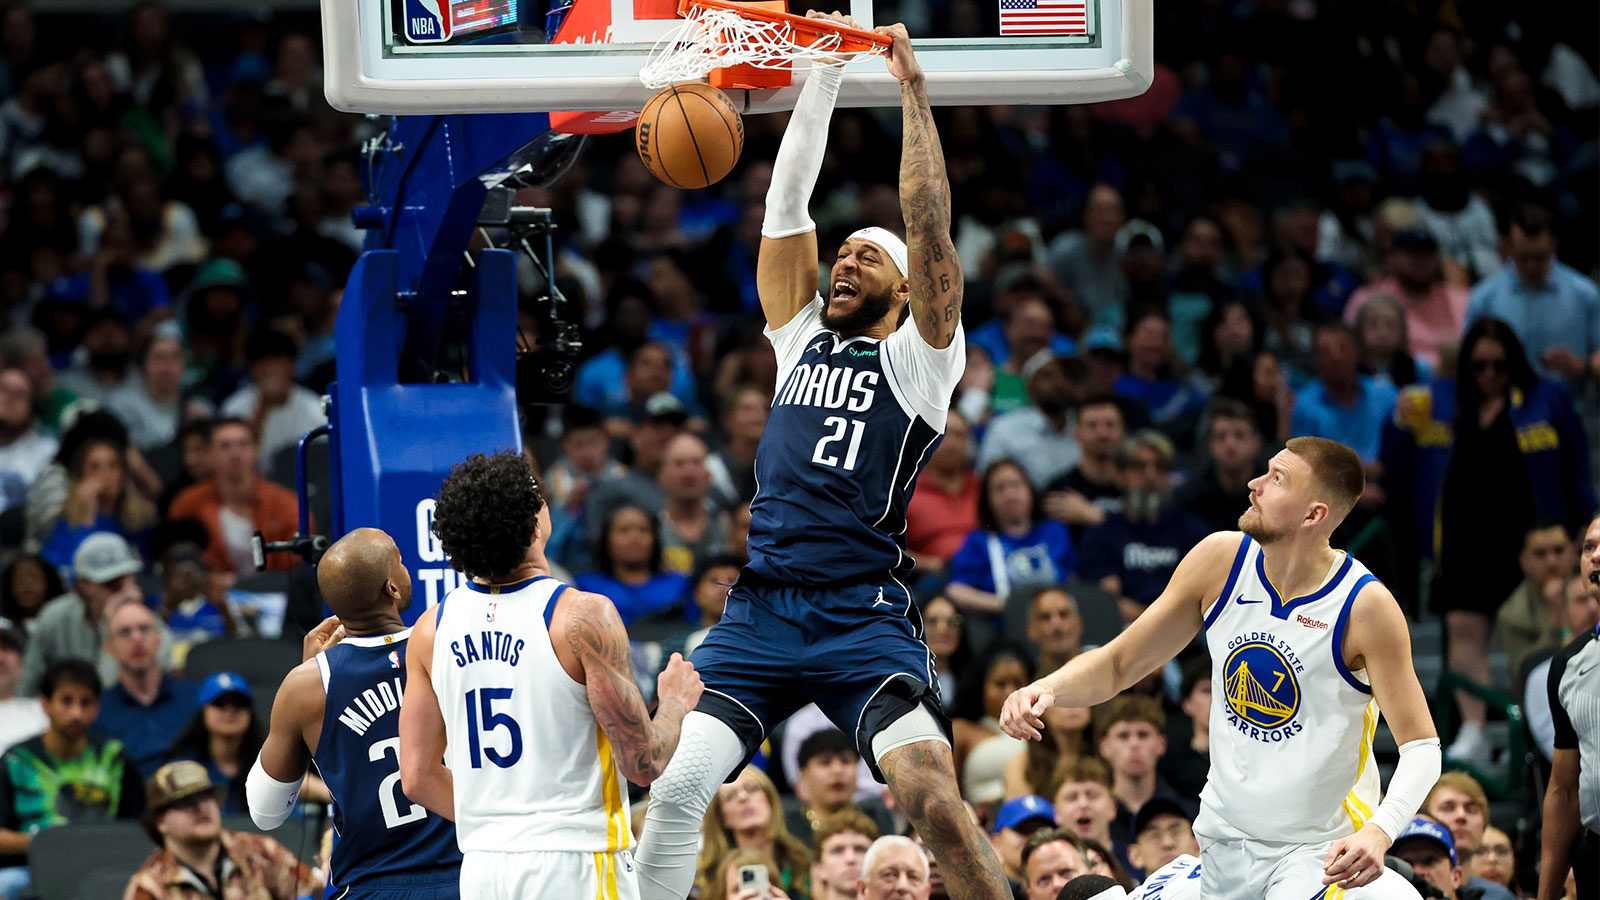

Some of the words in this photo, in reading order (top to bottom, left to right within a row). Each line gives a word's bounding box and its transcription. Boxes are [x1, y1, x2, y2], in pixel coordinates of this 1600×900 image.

[411, 17, 436, 35] NBA
[849, 347, 878, 358] Chime
[778, 363, 880, 413] MAVS
[811, 415, 866, 471] 21
[1296, 614, 1329, 630] Rakuten
[450, 630, 525, 668] SANTOS
[1227, 631, 1276, 650] GOLDEN
[1277, 640, 1305, 674] STATE
[1271, 670, 1286, 693] 7
[464, 687, 524, 770] 15
